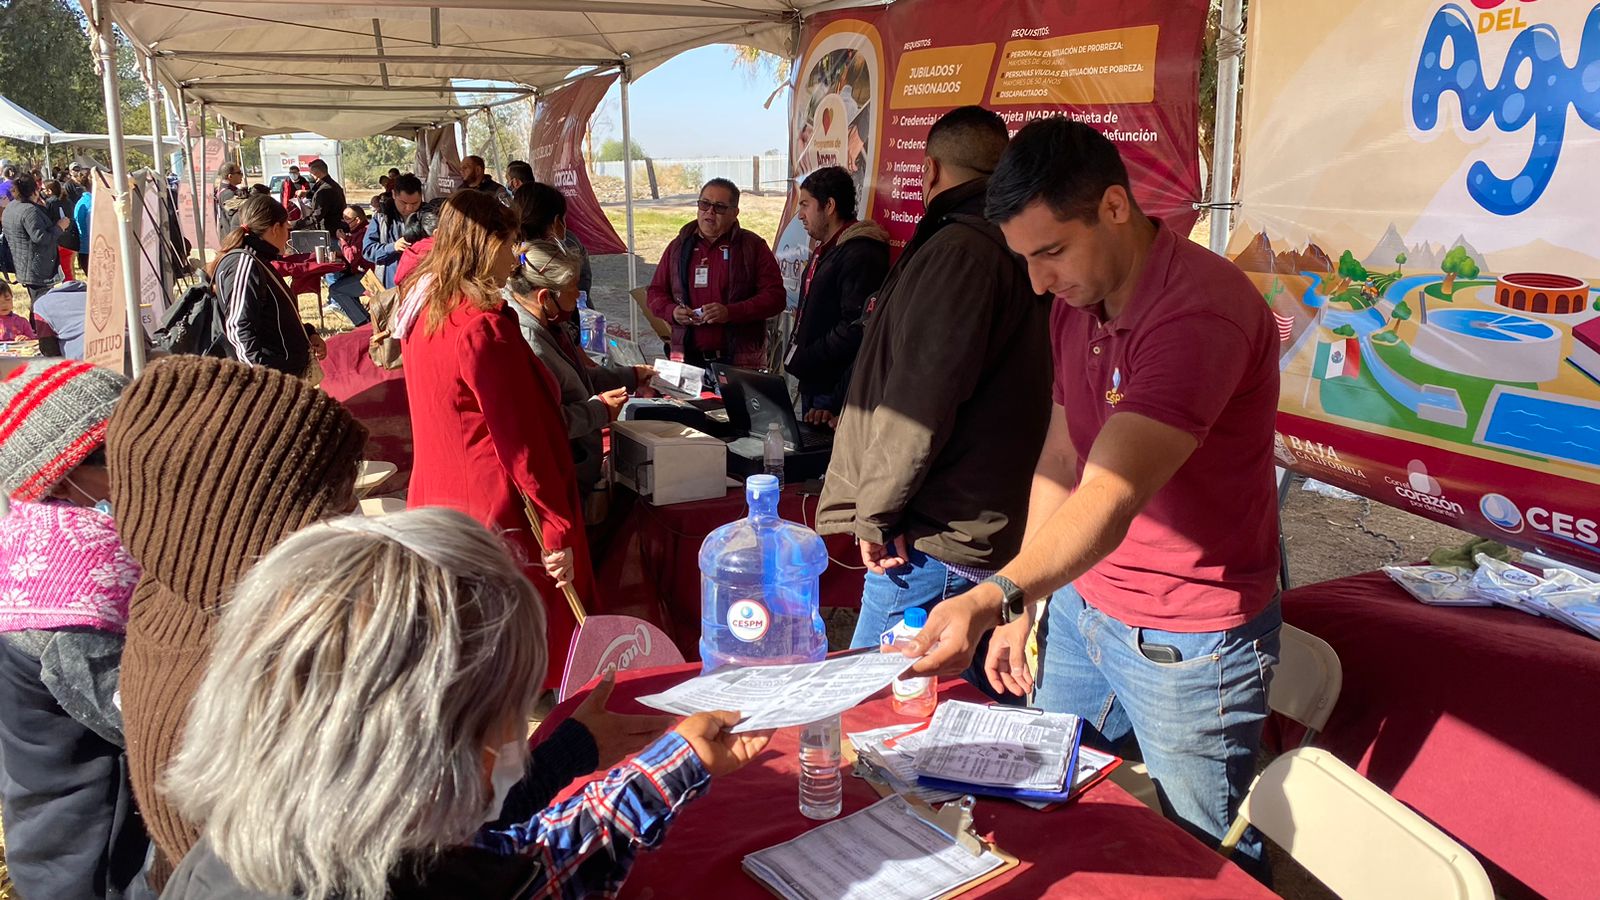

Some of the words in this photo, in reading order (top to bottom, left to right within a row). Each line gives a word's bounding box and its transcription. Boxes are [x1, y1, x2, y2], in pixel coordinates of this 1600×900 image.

[1477, 6, 1527, 34] DEL
[1011, 26, 1050, 38] REQUISITOS:
[903, 38, 932, 50] REQUISITOS:
[1010, 49, 1043, 59] PERSONAS
[1043, 49, 1051, 57] EN
[1078, 45, 1087, 54] DE
[1087, 42, 1123, 53] PROBREZA:
[909, 64, 955, 79] JUBILADOS
[955, 64, 963, 75] Y
[1004, 68, 1034, 79] PERSONAS
[1034, 68, 1060, 77] VIUDAS
[1060, 69, 1069, 78] EN
[1099, 66, 1108, 74] DE
[1108, 63, 1144, 73] POBREZA:
[903, 81, 962, 96] PENSIONADOS
[999, 88, 1049, 98] DISCAPACITADOS
[900, 113, 937, 126] Credencial
[1071, 111, 1101, 125] tarjeta
[1103, 111, 1118, 123] de
[893, 161, 920, 173] Informe
[892, 175, 901, 186] de
[891, 188, 900, 199] de
[890, 210, 914, 223] Recibo
[1288, 434, 1341, 462] BAJA
[1295, 450, 1367, 479] CALIFORNIA
[1384, 475, 1402, 487] Con
[1402, 481, 1411, 489] el
[1395, 486, 1465, 515] corazón
[732, 619, 763, 628] CESPM
